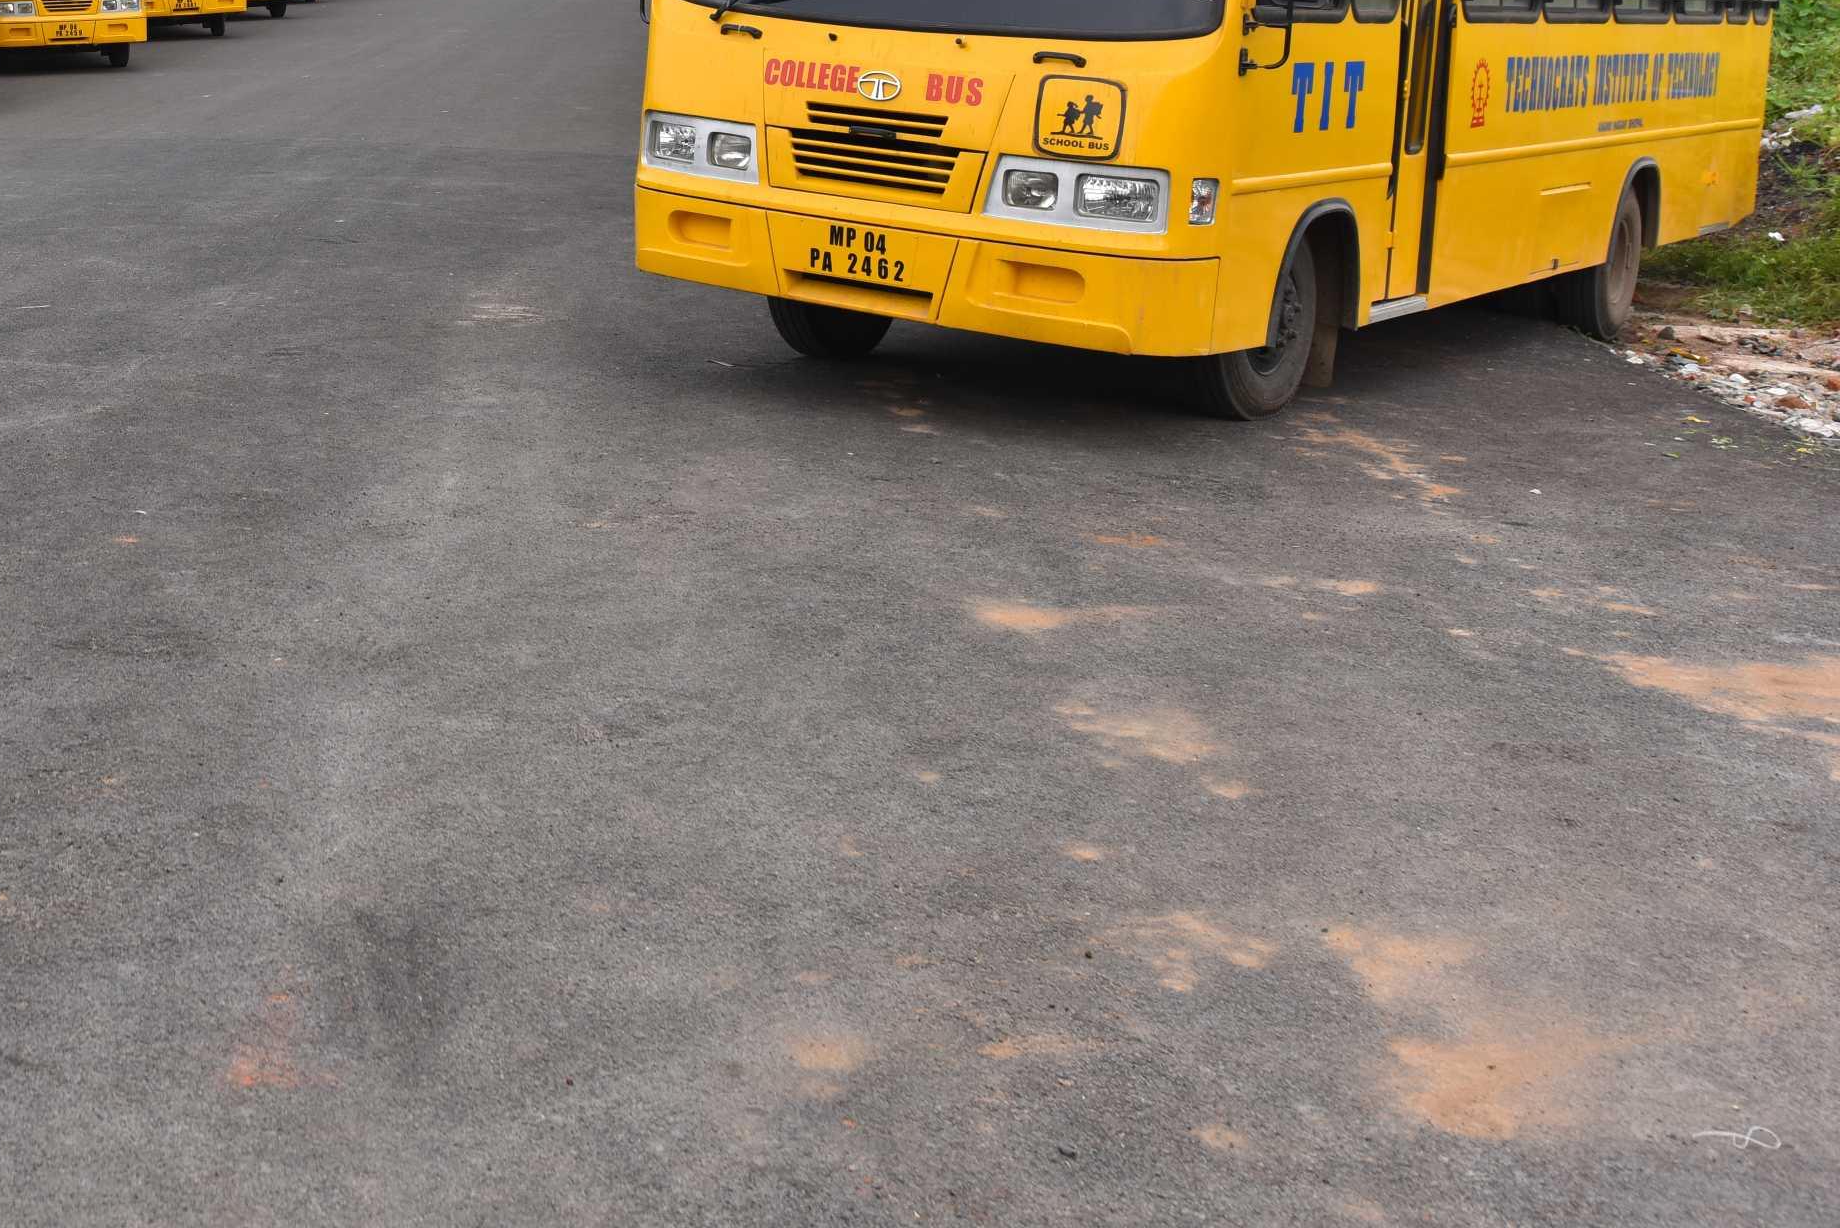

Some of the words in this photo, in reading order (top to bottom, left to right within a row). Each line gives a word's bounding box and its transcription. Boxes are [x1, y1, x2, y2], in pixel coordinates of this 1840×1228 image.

[764, 58, 860, 93] COLLEGE
[925, 73, 985, 107] BUS
[1291, 60, 1366, 134] TIT
[1505, 55, 1590, 114] TECHNOCRATS
[1593, 53, 1650, 107] INSTITUTE
[1651, 53, 1665, 102] OF
[1667, 51, 1721, 101] TECHNOLOGY
[1042, 136, 1085, 150] SCHOOL
[1088, 142, 1111, 151] BUS
[828, 225, 857, 249] MP
[863, 233, 887, 256] 04
[809, 247, 833, 273] PA
[847, 253, 905, 283] 2462
